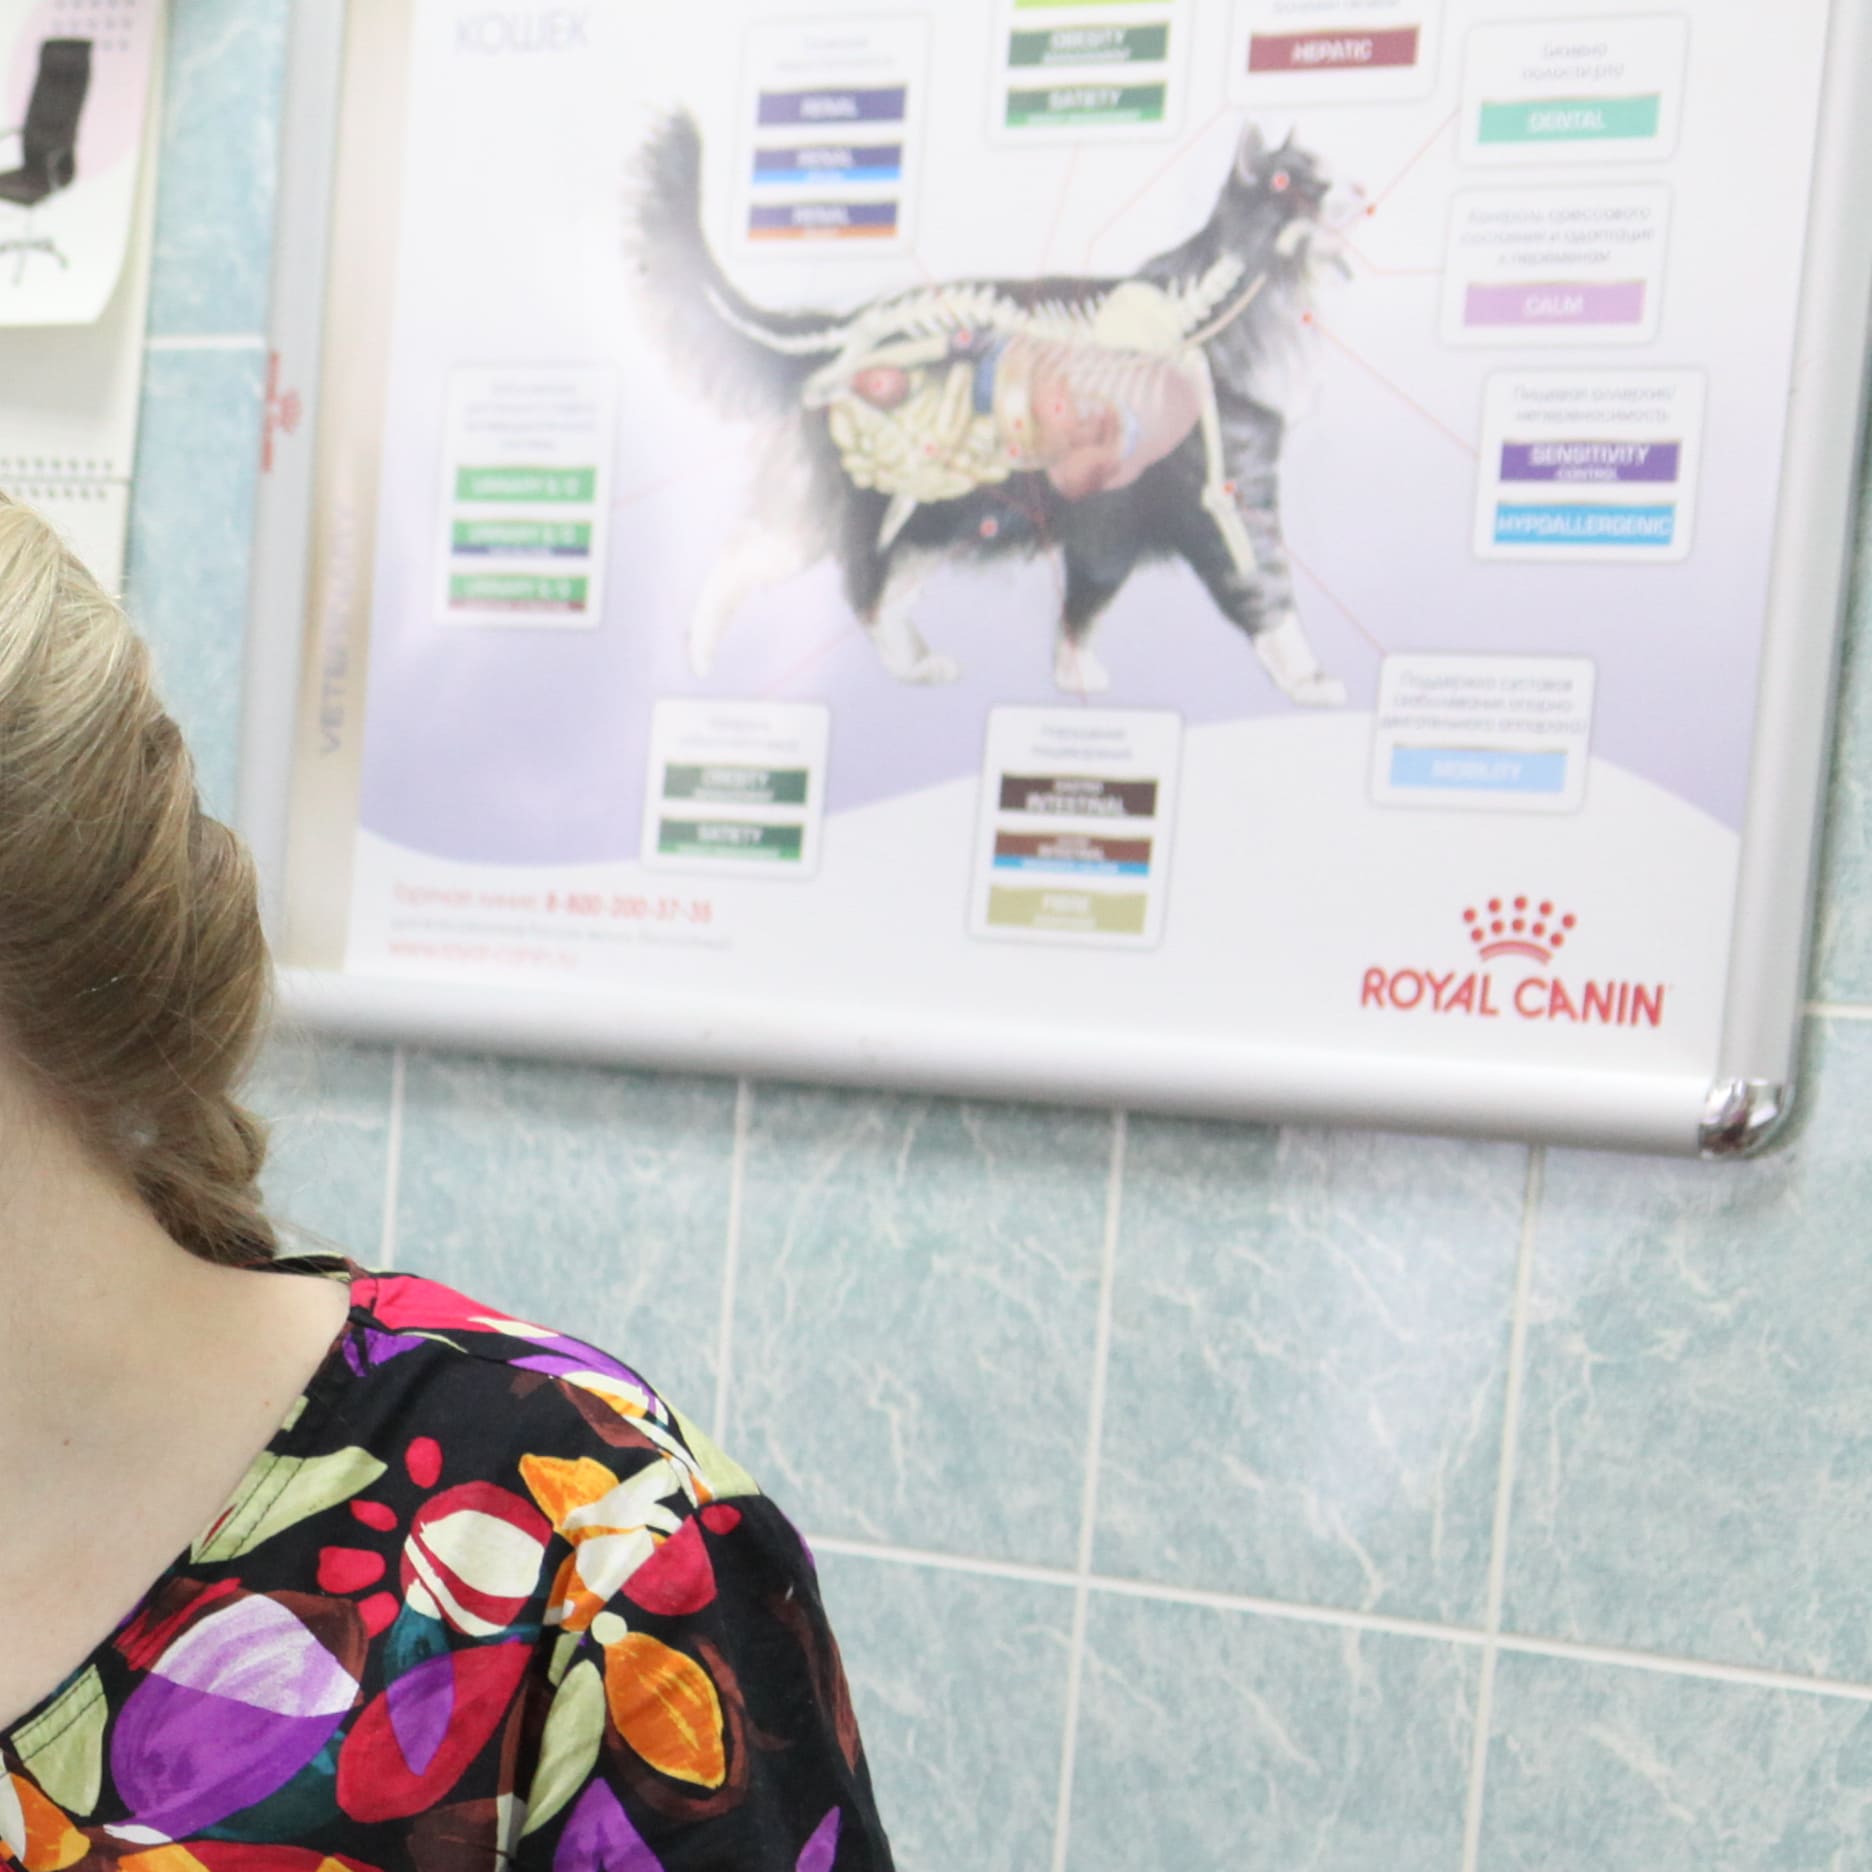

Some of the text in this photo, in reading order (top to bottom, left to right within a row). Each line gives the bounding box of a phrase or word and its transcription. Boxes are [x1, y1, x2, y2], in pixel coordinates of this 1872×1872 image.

[454, 11, 589, 56] КОШЕК
[1290, 38, 1373, 63] HEPATIC
[1048, 88, 1122, 110] SATIETY
[1527, 108, 1607, 132] DENTAL
[1523, 293, 1584, 317] CALM
[1528, 443, 1652, 466] SENSITIVITY
[1497, 513, 1674, 537] HYPOALLERGENIC
[1360, 965, 1666, 1029] ROYAL CANIN
